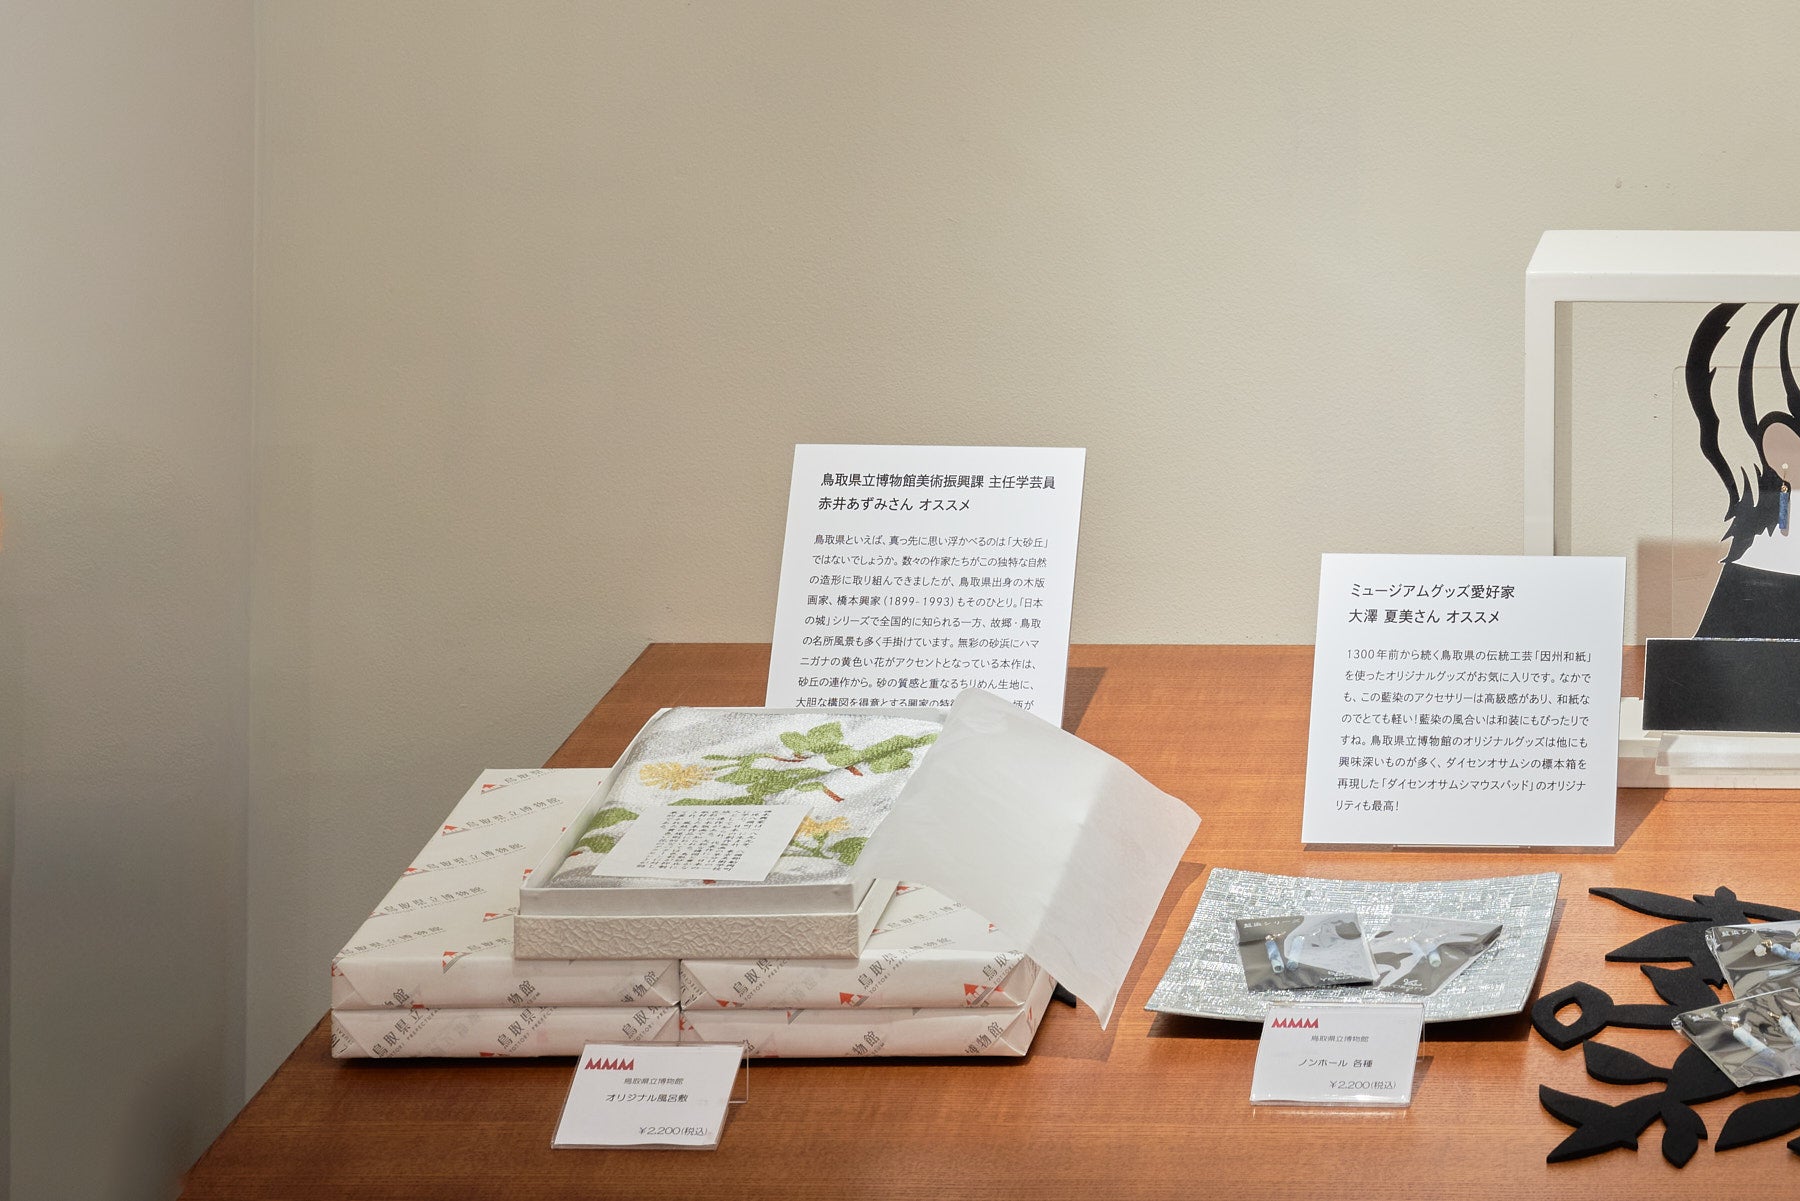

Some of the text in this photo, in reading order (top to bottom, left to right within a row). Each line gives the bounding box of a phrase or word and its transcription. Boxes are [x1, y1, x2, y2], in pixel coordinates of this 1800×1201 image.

[821, 473, 1055, 489] 鳥取県立博物館美術振興課 主任学芸員
[818, 497, 969, 511] 赤井あずみさん オススメ
[812, 554, 1047, 568] ではないでしょうか。数々の作家たちがこの独特な自然
[809, 575, 1045, 588] の造形に取り組んできましたが、鳥取県出身の木版
[1352, 584, 1514, 599] ミュージアムグッズ愛好家
[1349, 609, 1499, 623] 大澤 夏美さん オススメ
[1345, 670, 1591, 684] を使ったオリジナルグッズがお気に入りです。なかで
[1343, 691, 1590, 705] も、この藍染のアクセサリーは高級感があり、和紙な
[1340, 734, 1588, 747] すね。鳥取県立博物館のオリジナルグッズは他にも
[1338, 756, 1586, 769] 興味深いものが多く、ダイセンオサムシの標本箱を
[1311, 1035, 1369, 1043] 鳥取県立博物館
[1298, 1059, 1373, 1068] ノンホール 各種
[605, 1093, 688, 1102] オリジナル風呂敷
